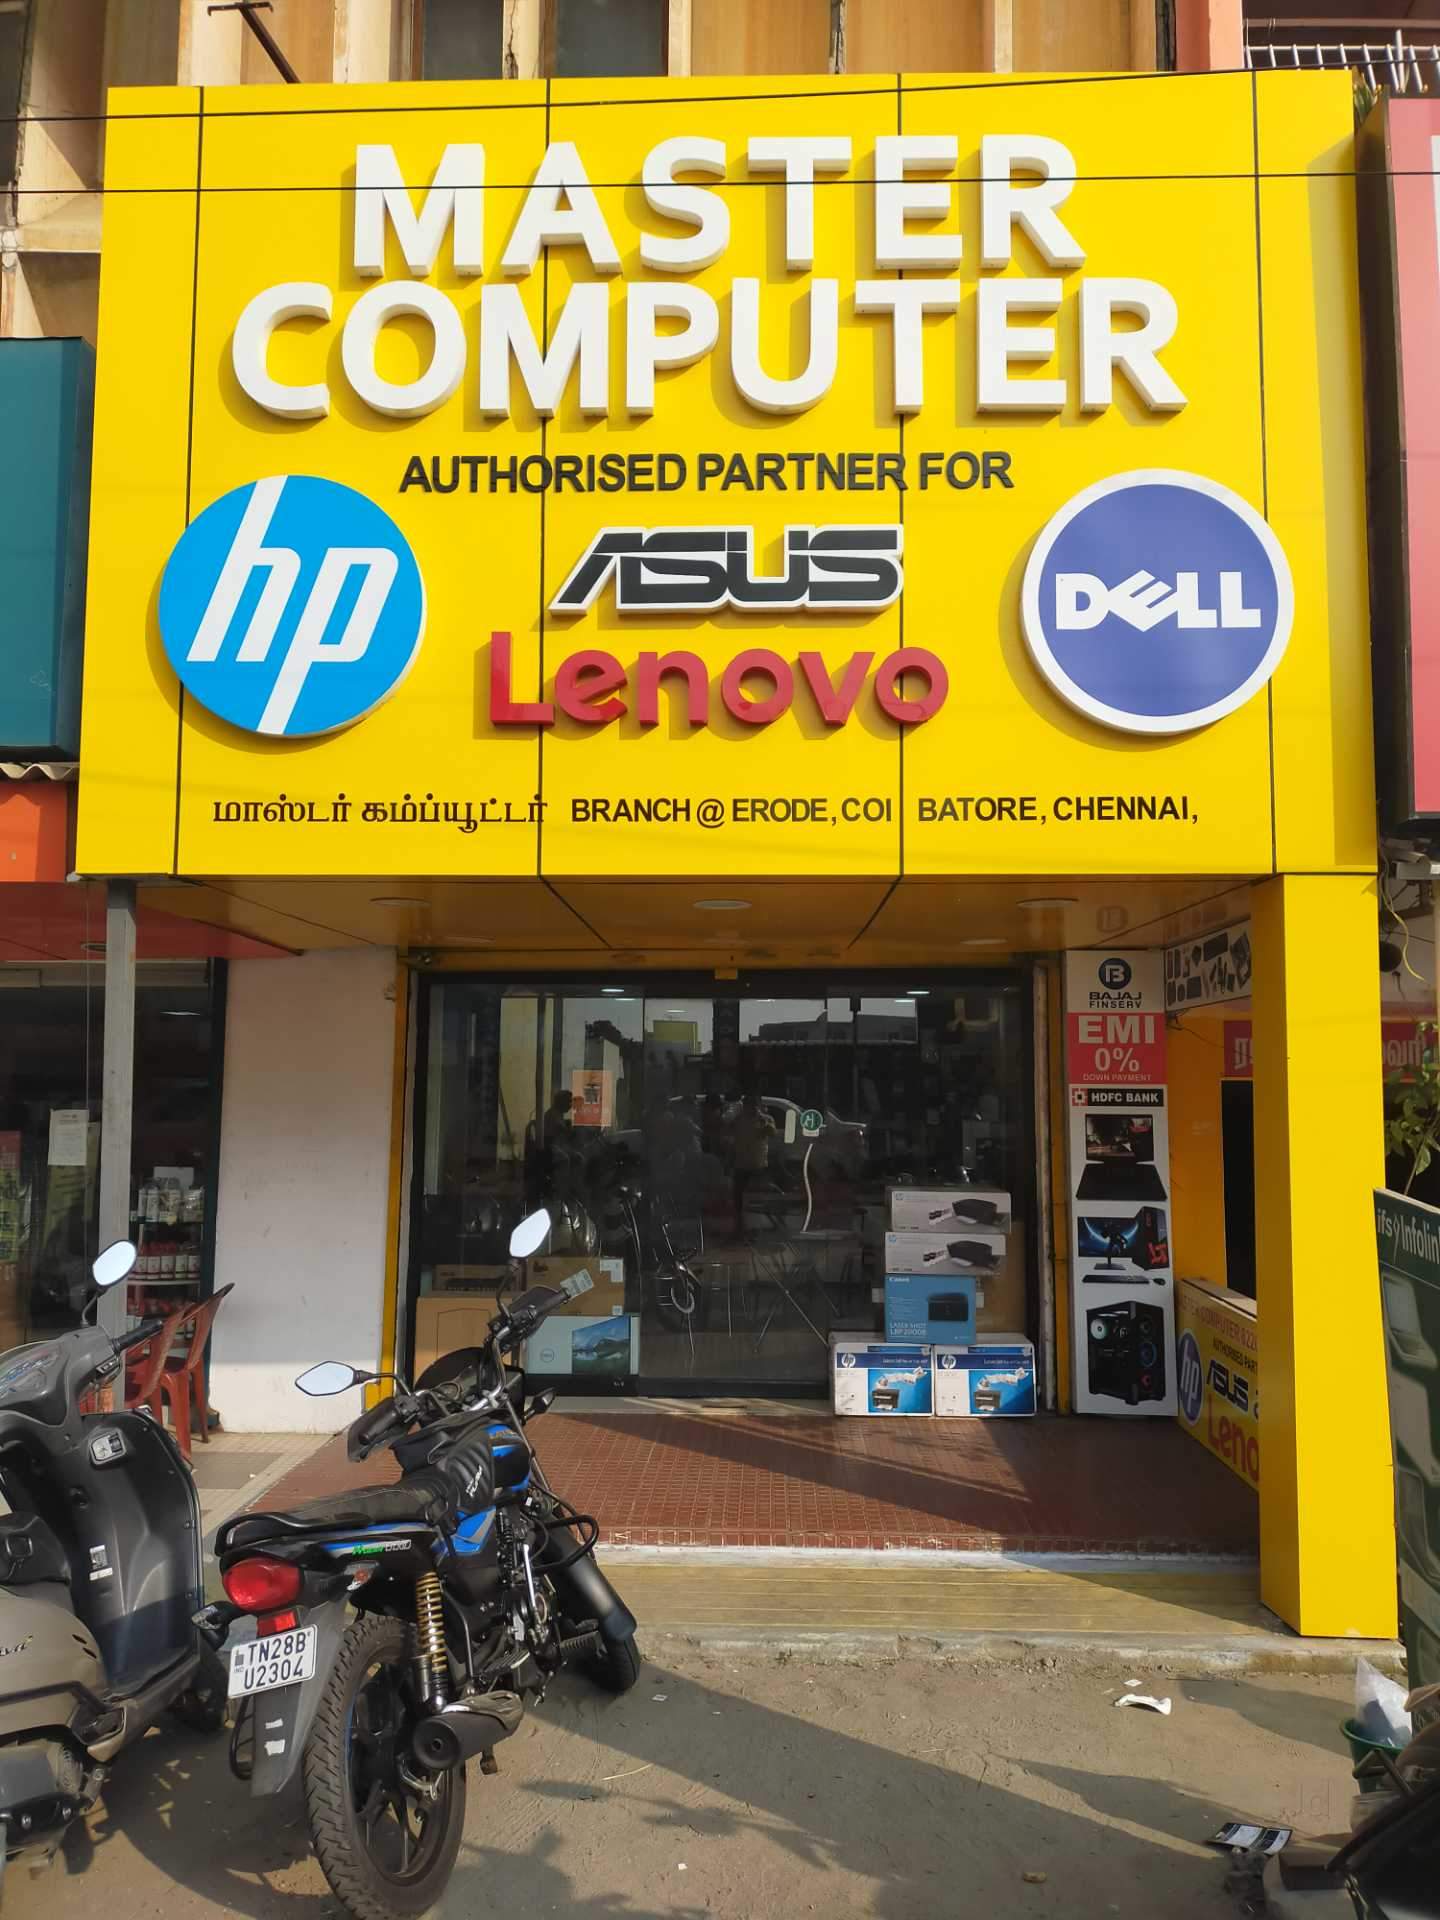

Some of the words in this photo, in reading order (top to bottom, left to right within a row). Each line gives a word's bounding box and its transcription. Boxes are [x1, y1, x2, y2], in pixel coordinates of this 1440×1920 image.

[353, 135, 1086, 276] MASTER
[232, 276, 1188, 420] COMPUTER
[402, 456, 683, 495] AUTHORISED
[699, 454, 906, 491] PARTNER
[920, 451, 1014, 490] FOR
[549, 525, 904, 615] ASUS
[187, 475, 399, 735] hp
[1053, 568, 1264, 632] DELL
[489, 631, 949, 732] Lenovo
[571, 798, 691, 823] BRANCH
[1089, 991, 1142, 1000] BAJAJ
[1089, 1001, 1142, 1009] FINSERV
[1078, 1015, 1155, 1044] EMI
[1083, 1073, 1110, 1081] DOWN
[1112, 1073, 1152, 1081] PAYMENT
[1094, 1047, 1140, 1072] 0%
[1090, 1092, 1122, 1103] HDFC
[1126, 1092, 1159, 1103] BANK
[248, 1631, 307, 1666] TN28B
[244, 1655, 304, 1690] U2304
